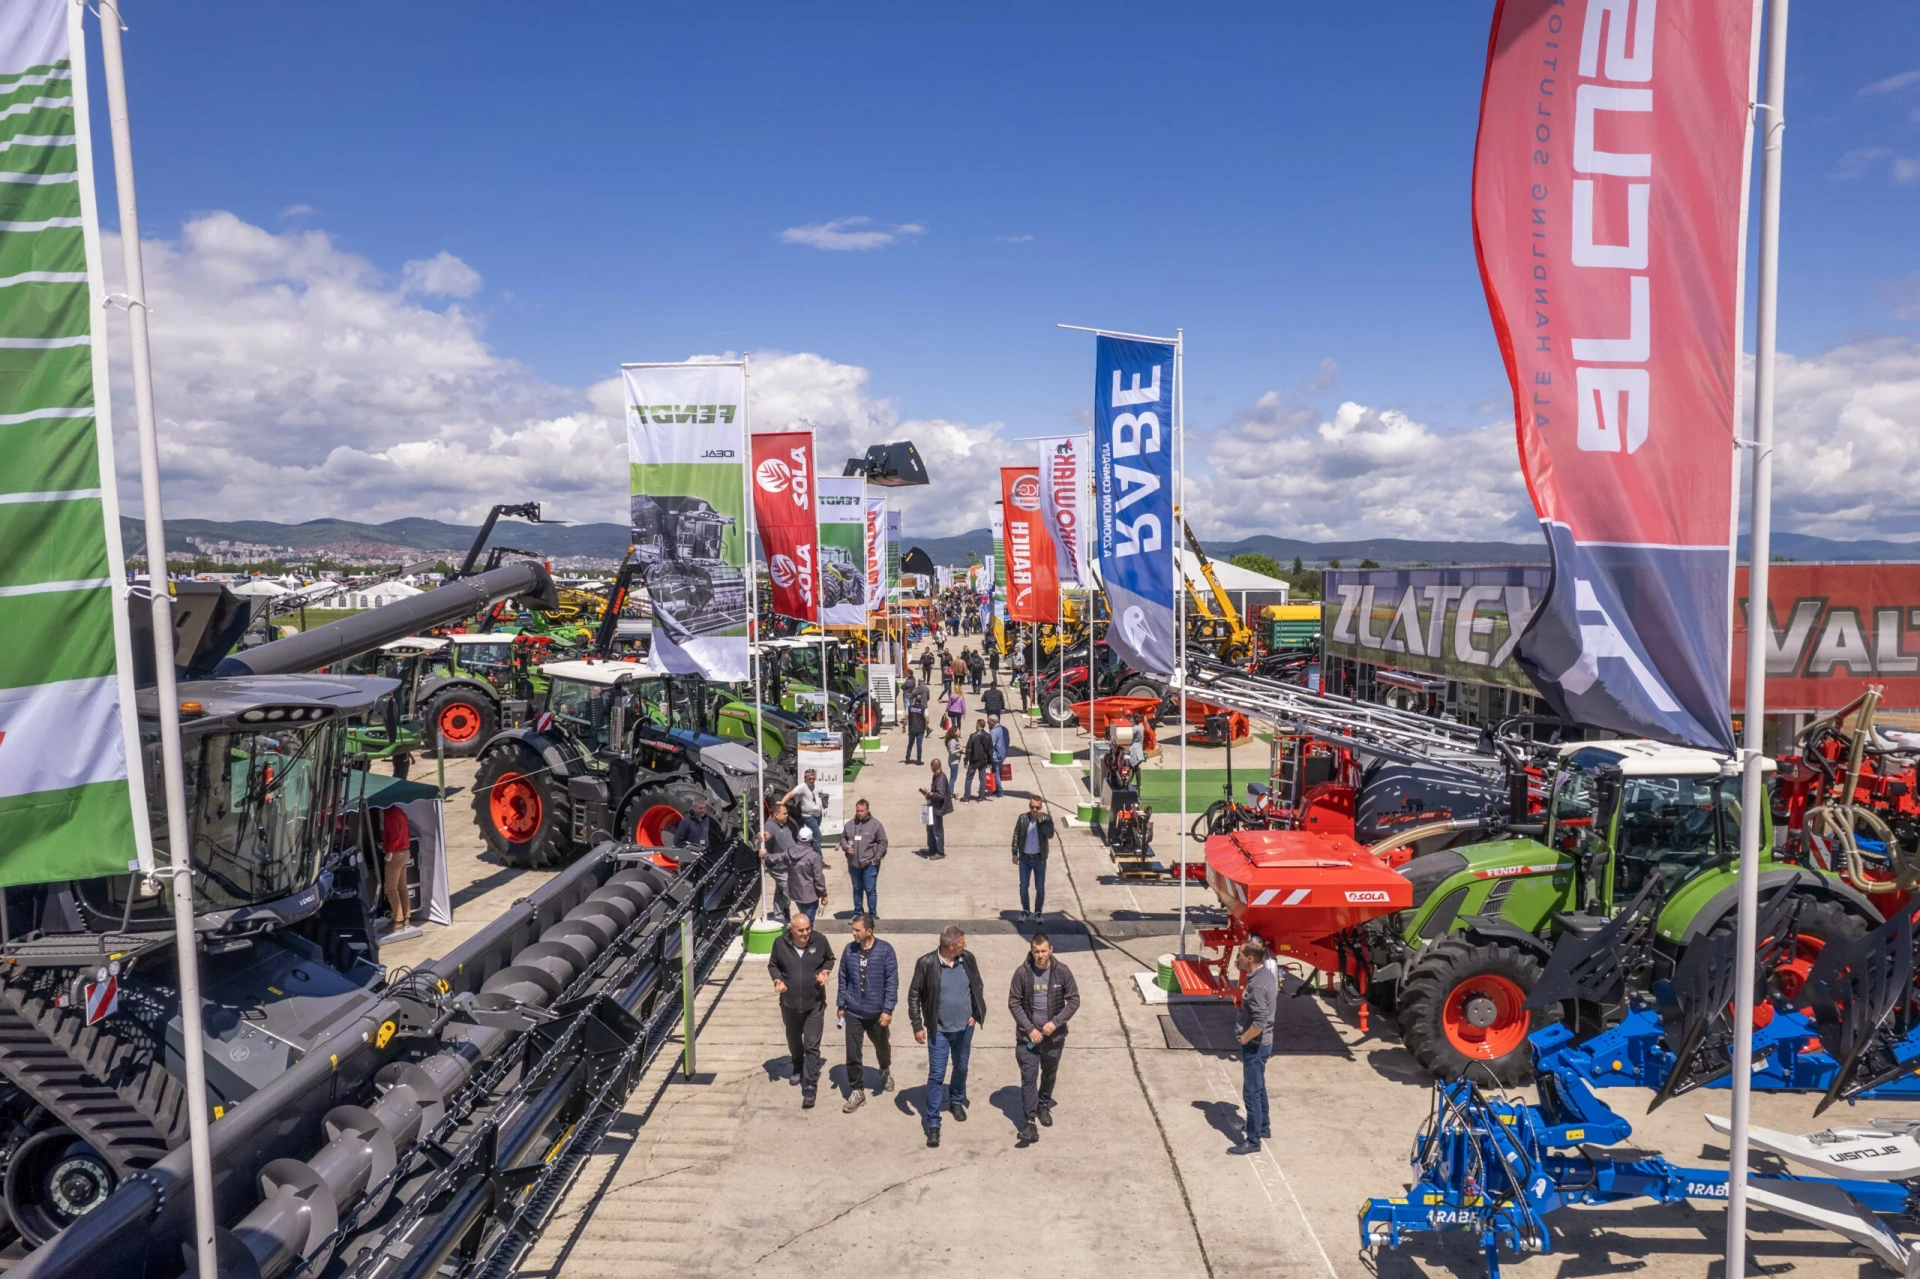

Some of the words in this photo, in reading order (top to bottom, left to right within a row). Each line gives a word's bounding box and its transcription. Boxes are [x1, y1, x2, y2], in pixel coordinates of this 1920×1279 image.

[790, 446, 808, 511] SOLA
[795, 543, 812, 607] SOLA
[1332, 584, 1541, 668] ZLATEX
[1740, 598, 1920, 676] VAL
[656, 741, 675, 750] FENDT
[1486, 865, 1523, 877] FENDT
[1357, 893, 1385, 901] SOLA
[1828, 1145, 1902, 1163] arcusin
